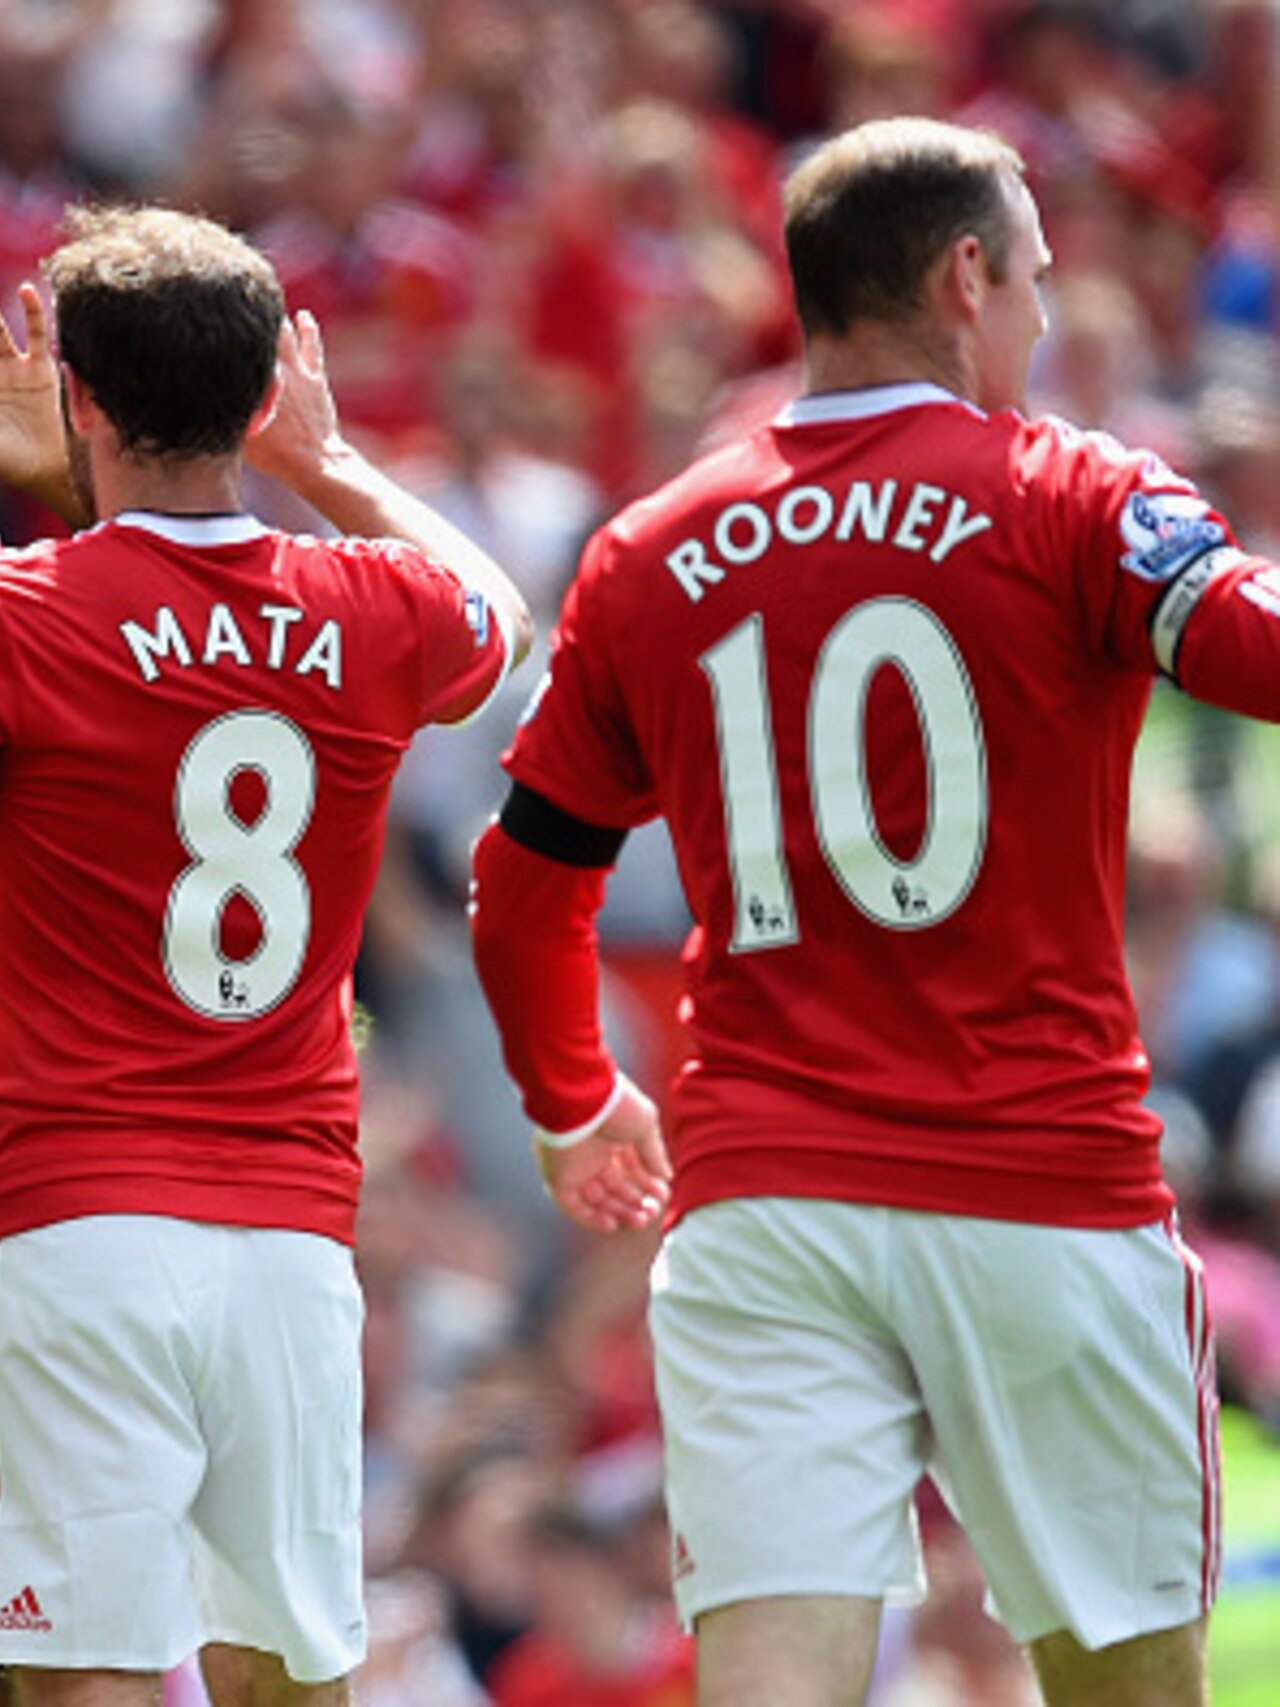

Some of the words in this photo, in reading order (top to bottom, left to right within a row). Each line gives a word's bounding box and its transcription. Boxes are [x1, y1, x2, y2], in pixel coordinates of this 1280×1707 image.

[120, 602, 341, 689] MATA
[665, 479, 992, 602] ROONEY
[162, 707, 317, 1022] 8
[697, 595, 990, 954] 10
